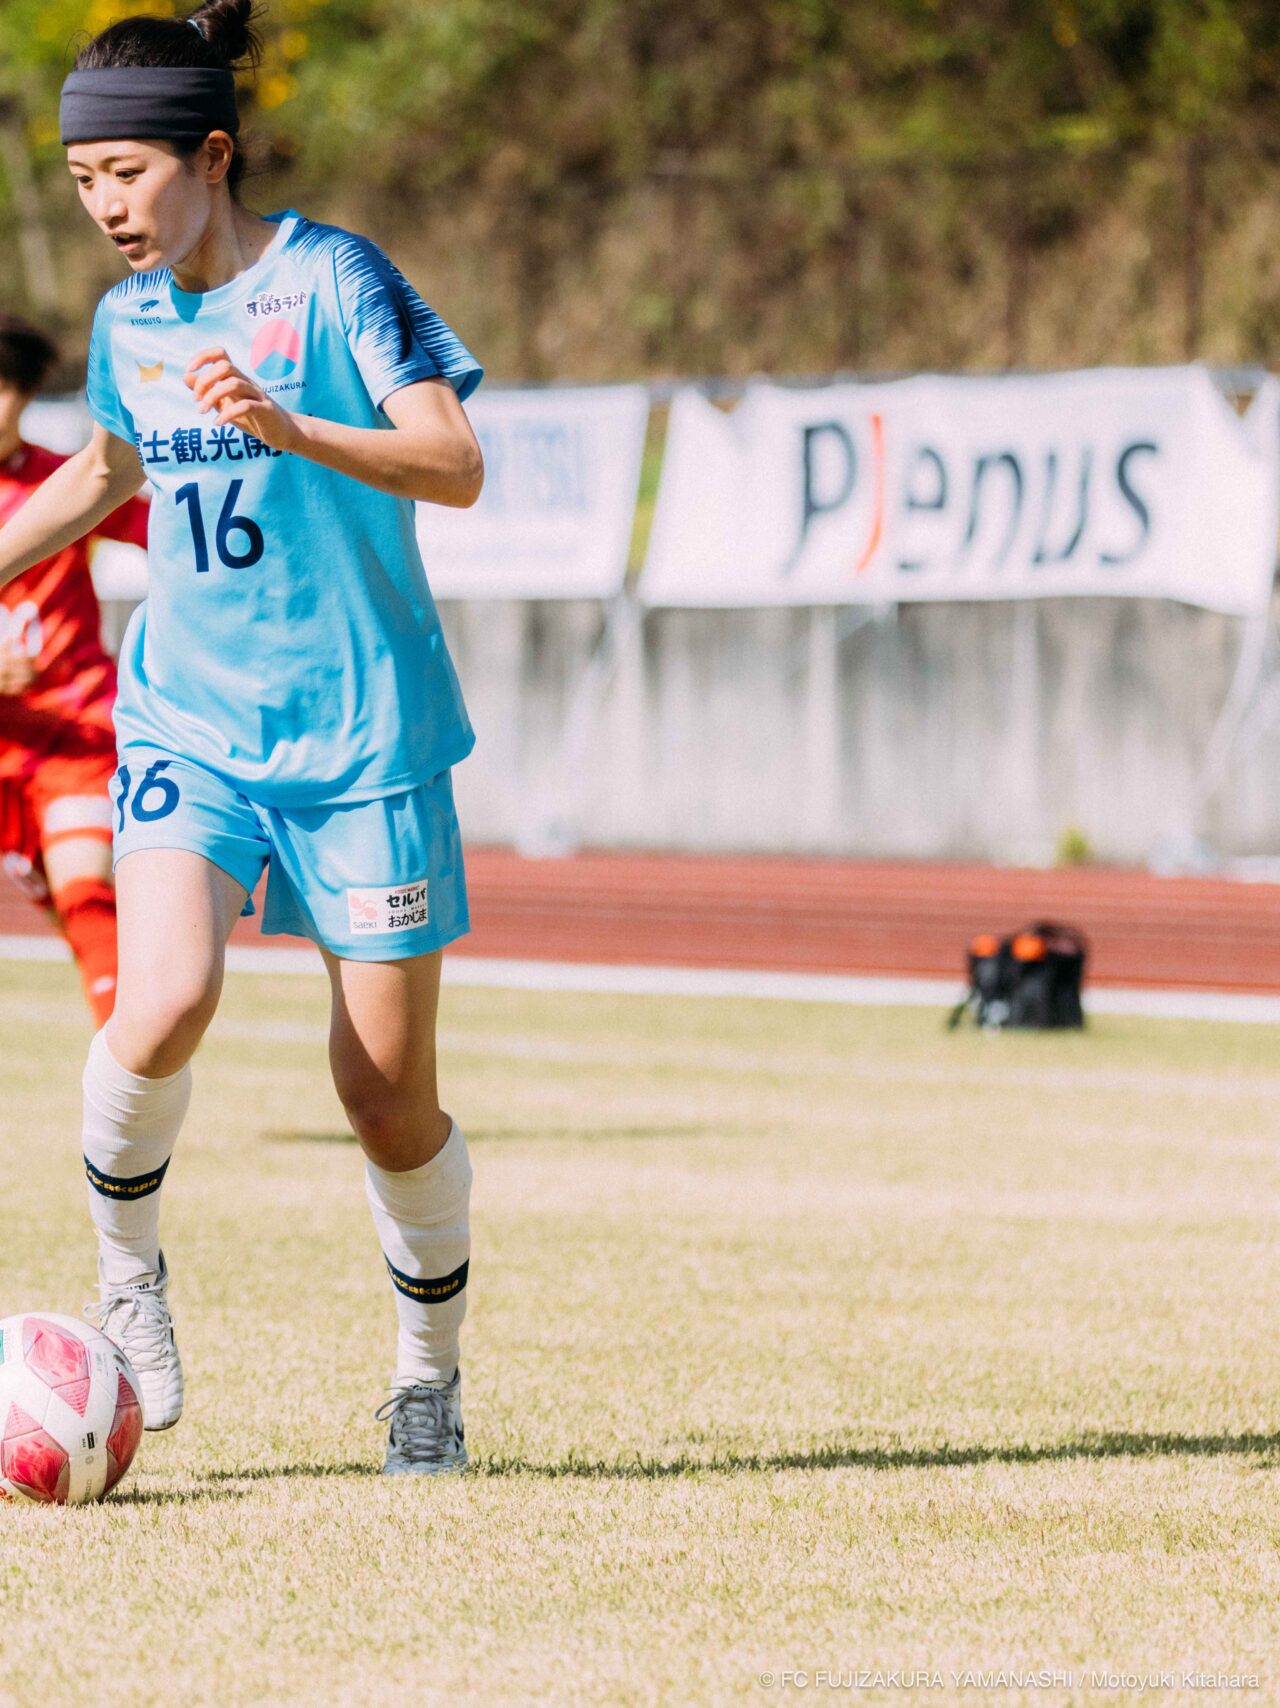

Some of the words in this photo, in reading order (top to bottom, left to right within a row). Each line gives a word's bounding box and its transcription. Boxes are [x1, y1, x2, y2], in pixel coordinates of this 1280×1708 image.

[262, 381, 307, 394] UJIZAKURA
[784, 413, 1159, 575] Plenus
[175, 478, 265, 574] 16
[116, 759, 181, 834] 16
[386, 888, 426, 909] セルバ
[388, 908, 428, 928] おかじま
